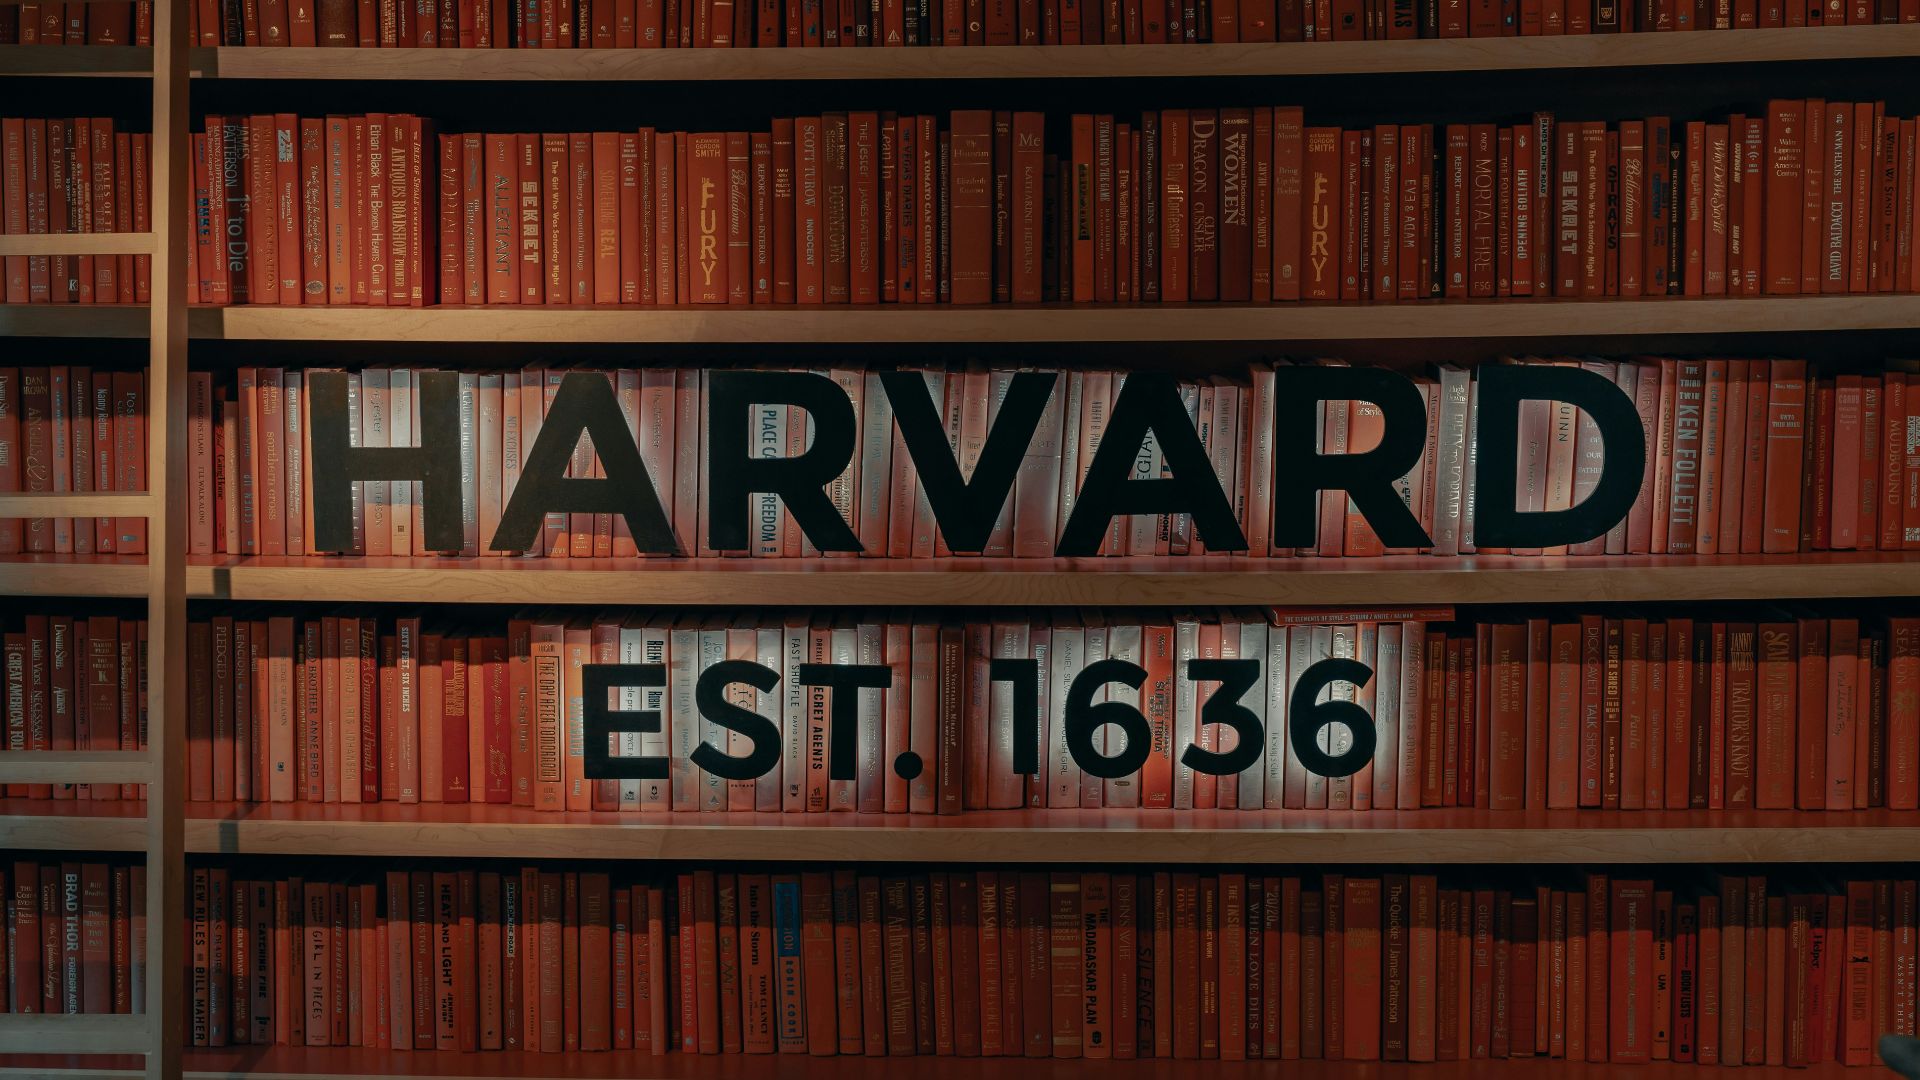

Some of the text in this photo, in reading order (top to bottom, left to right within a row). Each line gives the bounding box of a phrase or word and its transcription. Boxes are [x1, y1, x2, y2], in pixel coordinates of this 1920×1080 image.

[223, 125, 237, 187] PATTERSON
[236, 124, 250, 160] JAMES
[695, 150, 721, 158] SMITH
[804, 125, 815, 207] SCOTT TUROW
[857, 142, 871, 177] Jester
[881, 126, 895, 179] Lean In
[1192, 118, 1215, 193] DRAGON
[1309, 144, 1335, 152] SMITH
[1834, 130, 1843, 150] MAN
[1167, 184, 1183, 194] of
[1224, 132, 1239, 225] WOMEN
[1454, 155, 1462, 189] REPORT
[1500, 177, 1509, 218] FOURTH
[1588, 182, 1596, 200] Who
[1589, 166, 1597, 180] Girl
[1625, 158, 1641, 226] Belladonna
[370, 124, 385, 284] Ethan Black THE BROKEN HEARTS CLUB
[389, 147, 407, 287] ANTIQUES ROADSHOW PRIMER
[522, 181, 538, 264] SEKRET
[924, 150, 932, 281] A TOMATO CAN CHRONICLE
[1310, 177, 1328, 282] FURY
[1474, 159, 1492, 272] MORTAL FIRE
[1561, 170, 1578, 255] SEKRET
[227, 217, 249, 272] to Die
[600, 229, 615, 258] REAL
[700, 182, 718, 286] FURY
[758, 224, 766, 265] INTERIOR
[806, 218, 814, 266] INNOCENT
[860, 219, 869, 273] PATTERSON
[1500, 232, 1509, 256] JULY
[1829, 251, 1842, 280] DAVID
[762, 410, 777, 444] PLACE
[1907, 416, 1915, 455] EXPRESSIONS
[266, 431, 279, 520] southern cross
[310, 364, 1645, 557] HARVARD
[1673, 405, 1699, 525] KEN FOLLETT
[1888, 419, 1902, 505] MUDBOUND
[8, 652, 24, 727] GREAT AMERICAN
[309, 666, 317, 714] BROTHER
[401, 627, 410, 712] SIXTY SIX INCHES
[539, 679, 555, 696] DAY
[790, 638, 800, 707] FAST SHUFFLE
[1608, 671, 1617, 695] SHRED
[539, 699, 556, 725] AFTER
[583, 660, 923, 780] EST.
[990, 658, 1376, 778] 1636
[1586, 627, 1598, 771] DICK TALK SHOW
[1731, 680, 1750, 742] TRAITOR'S
[310, 720, 318, 749] ANNE
[363, 736, 376, 772] French
[813, 726, 824, 770] AGENTS
[1731, 743, 1749, 777] KNOT
[65, 873, 79, 951] BRAD THOR
[195, 875, 205, 946] NEW RULES
[440, 884, 451, 918] HEAT
[749, 885, 760, 908] Into
[1099, 908, 1108, 924] THE
[1389, 885, 1402, 940] The Quickie
[258, 922, 266, 998] CATCHING FIRE
[750, 931, 761, 966] Storm
[1475, 905, 1489, 967] citizen girl
[1812, 935, 1823, 969] Helper
[68, 956, 77, 992] FOREIGN
[312, 931, 324, 1020] GIRL IN PIECES
[442, 946, 452, 987] LIGHT
[1085, 913, 1098, 1025] MADAGASKAR PLAN
[1138, 947, 1153, 1030] SILENCE
[1249, 953, 1259, 992] LOVE
[1389, 948, 1401, 1023] James Patterson
[195, 966, 205, 1041] BILL MAHER
[1249, 997, 1259, 1030] DIES
